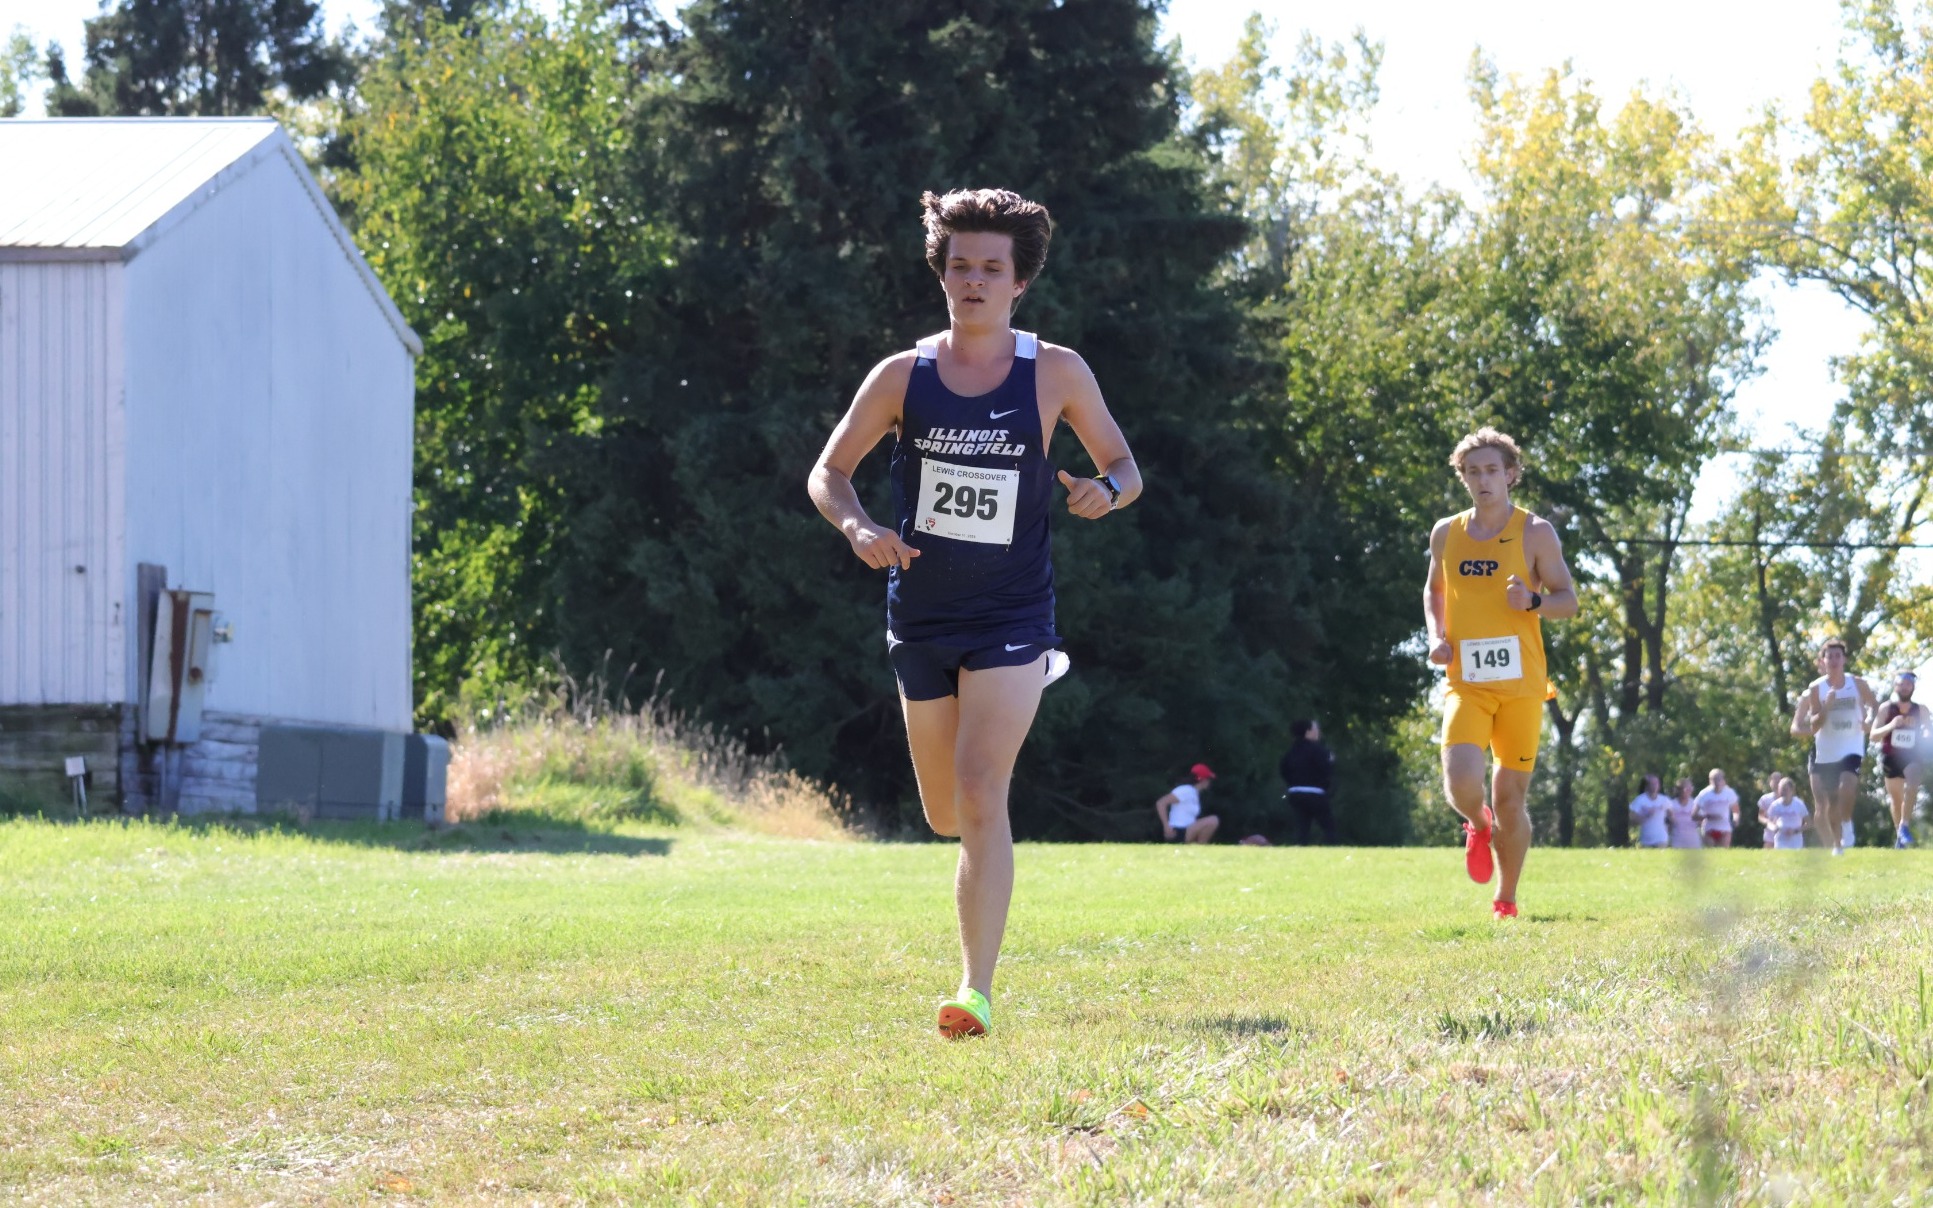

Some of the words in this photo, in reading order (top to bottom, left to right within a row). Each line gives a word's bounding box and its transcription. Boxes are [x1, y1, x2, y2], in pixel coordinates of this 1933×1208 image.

[927, 427, 1009, 442] ILLINOIS
[914, 438, 1026, 456] SPRINGFIELD
[932, 465, 955, 476] LEWIS
[956, 470, 1007, 482] CROSSOVER
[933, 482, 998, 521] 295
[1459, 560, 1498, 576] CSP
[1472, 648, 1510, 669] 149
